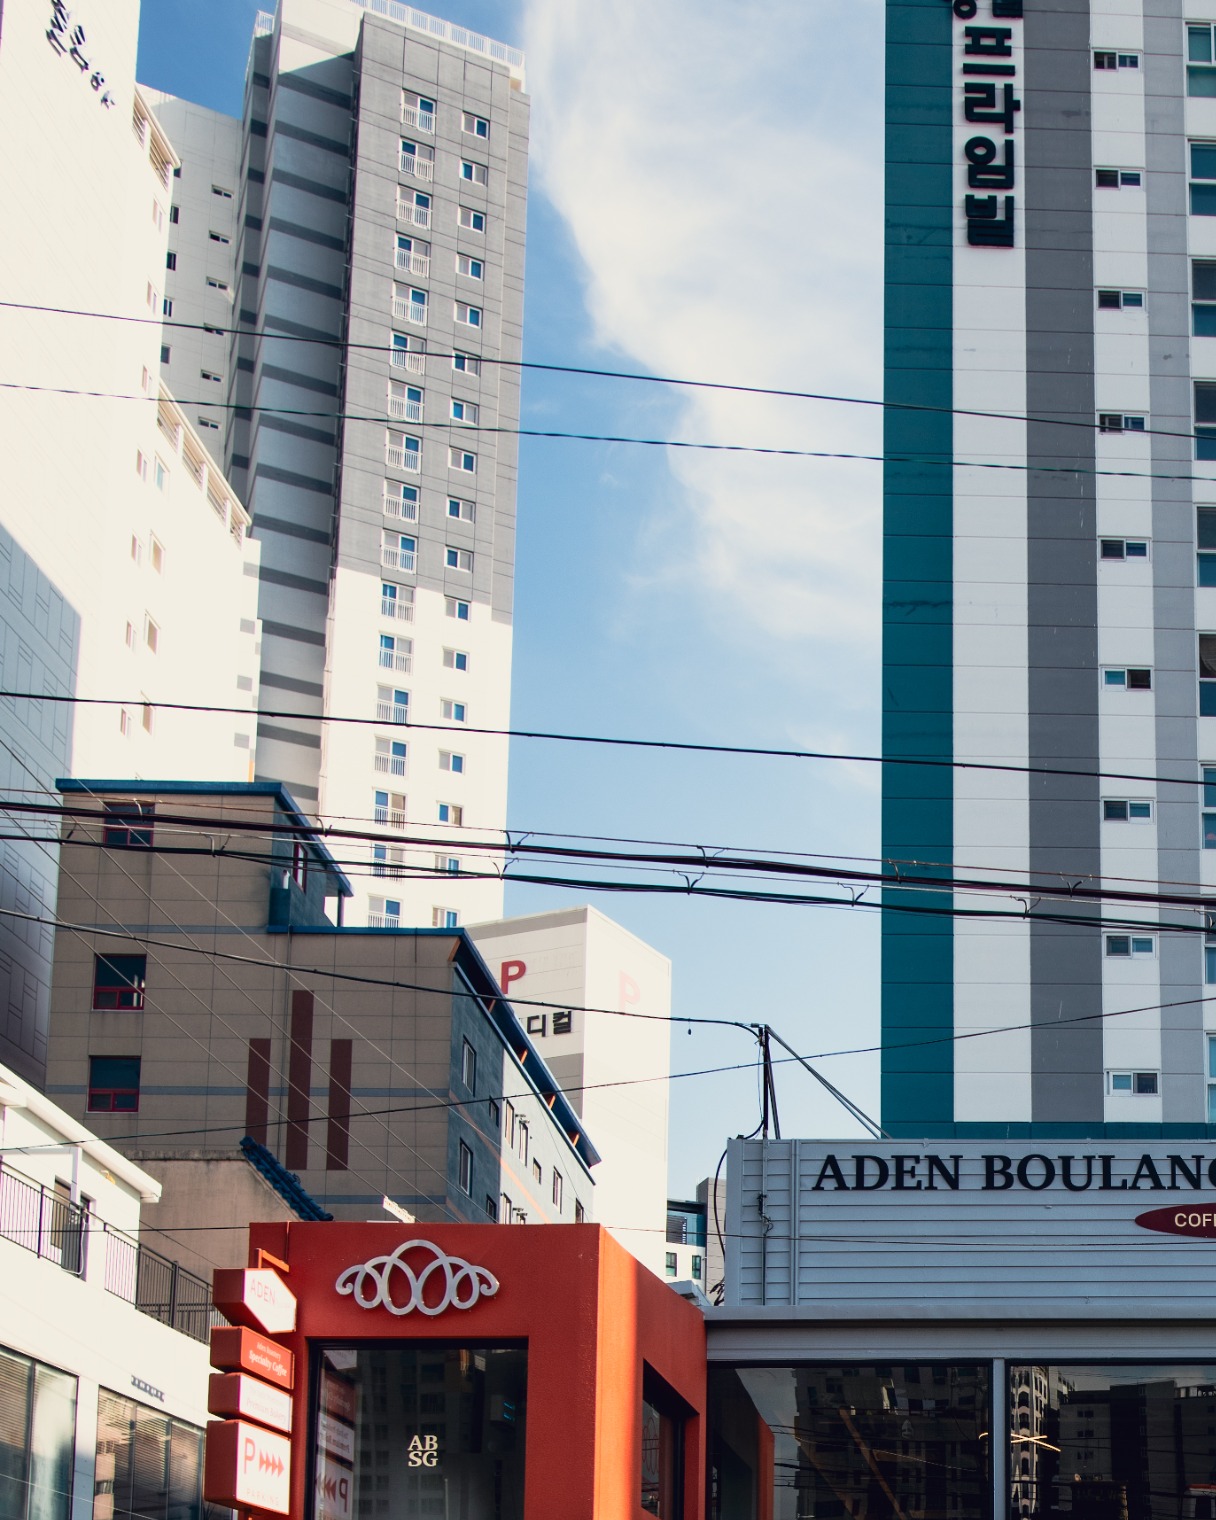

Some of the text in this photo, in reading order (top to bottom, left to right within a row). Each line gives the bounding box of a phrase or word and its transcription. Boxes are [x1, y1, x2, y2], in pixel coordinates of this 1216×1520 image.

[501, 959, 526, 995] P
[812, 1154, 964, 1191] ADEN
[244, 1437, 255, 1475] P
[407, 1434, 439, 1451] AB
[407, 1450, 439, 1467] SG
